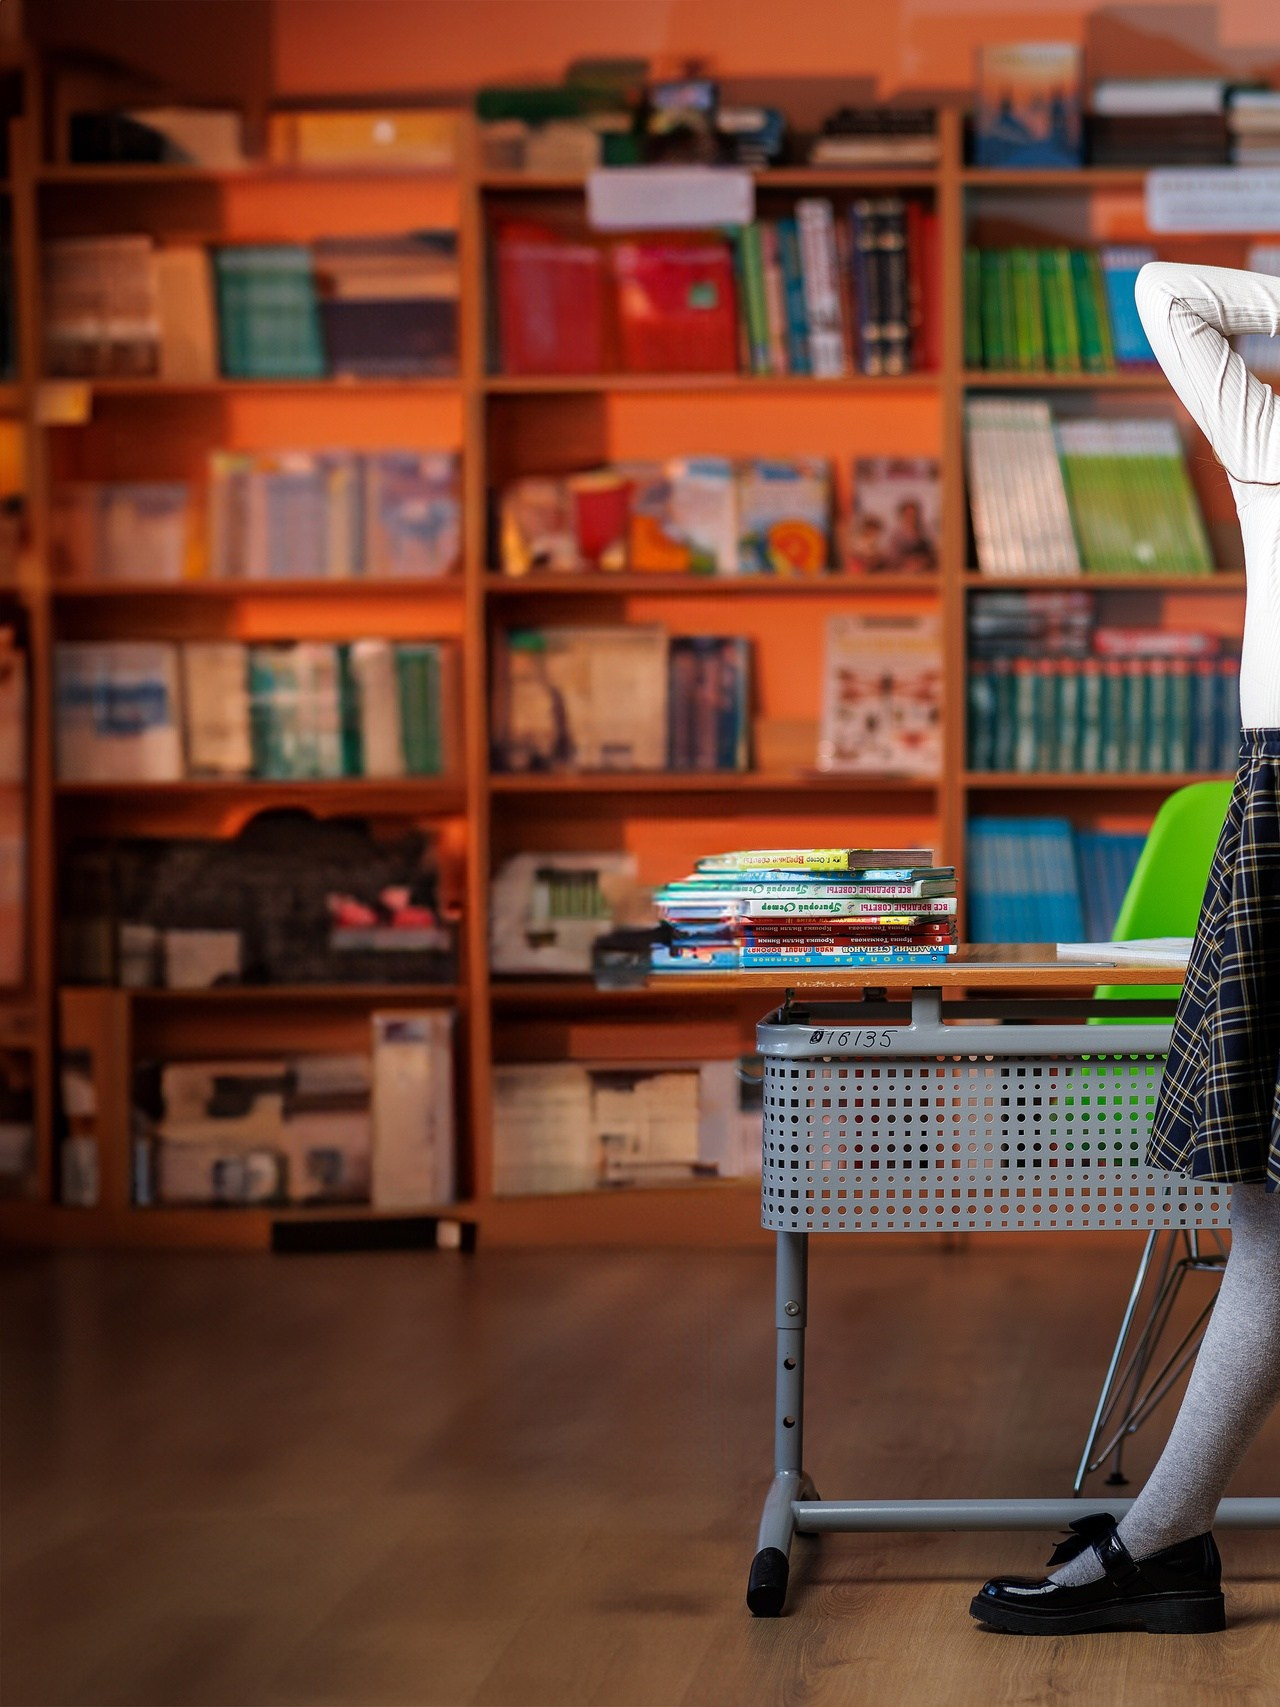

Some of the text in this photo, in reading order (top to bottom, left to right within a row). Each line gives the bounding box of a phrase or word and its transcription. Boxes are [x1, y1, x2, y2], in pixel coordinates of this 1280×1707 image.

[766, 884, 808, 894] Григорий
[762, 902, 796, 912] Остер
[798, 902, 842, 912] Григорий
[860, 904, 892, 912] СОВЕТЫ
